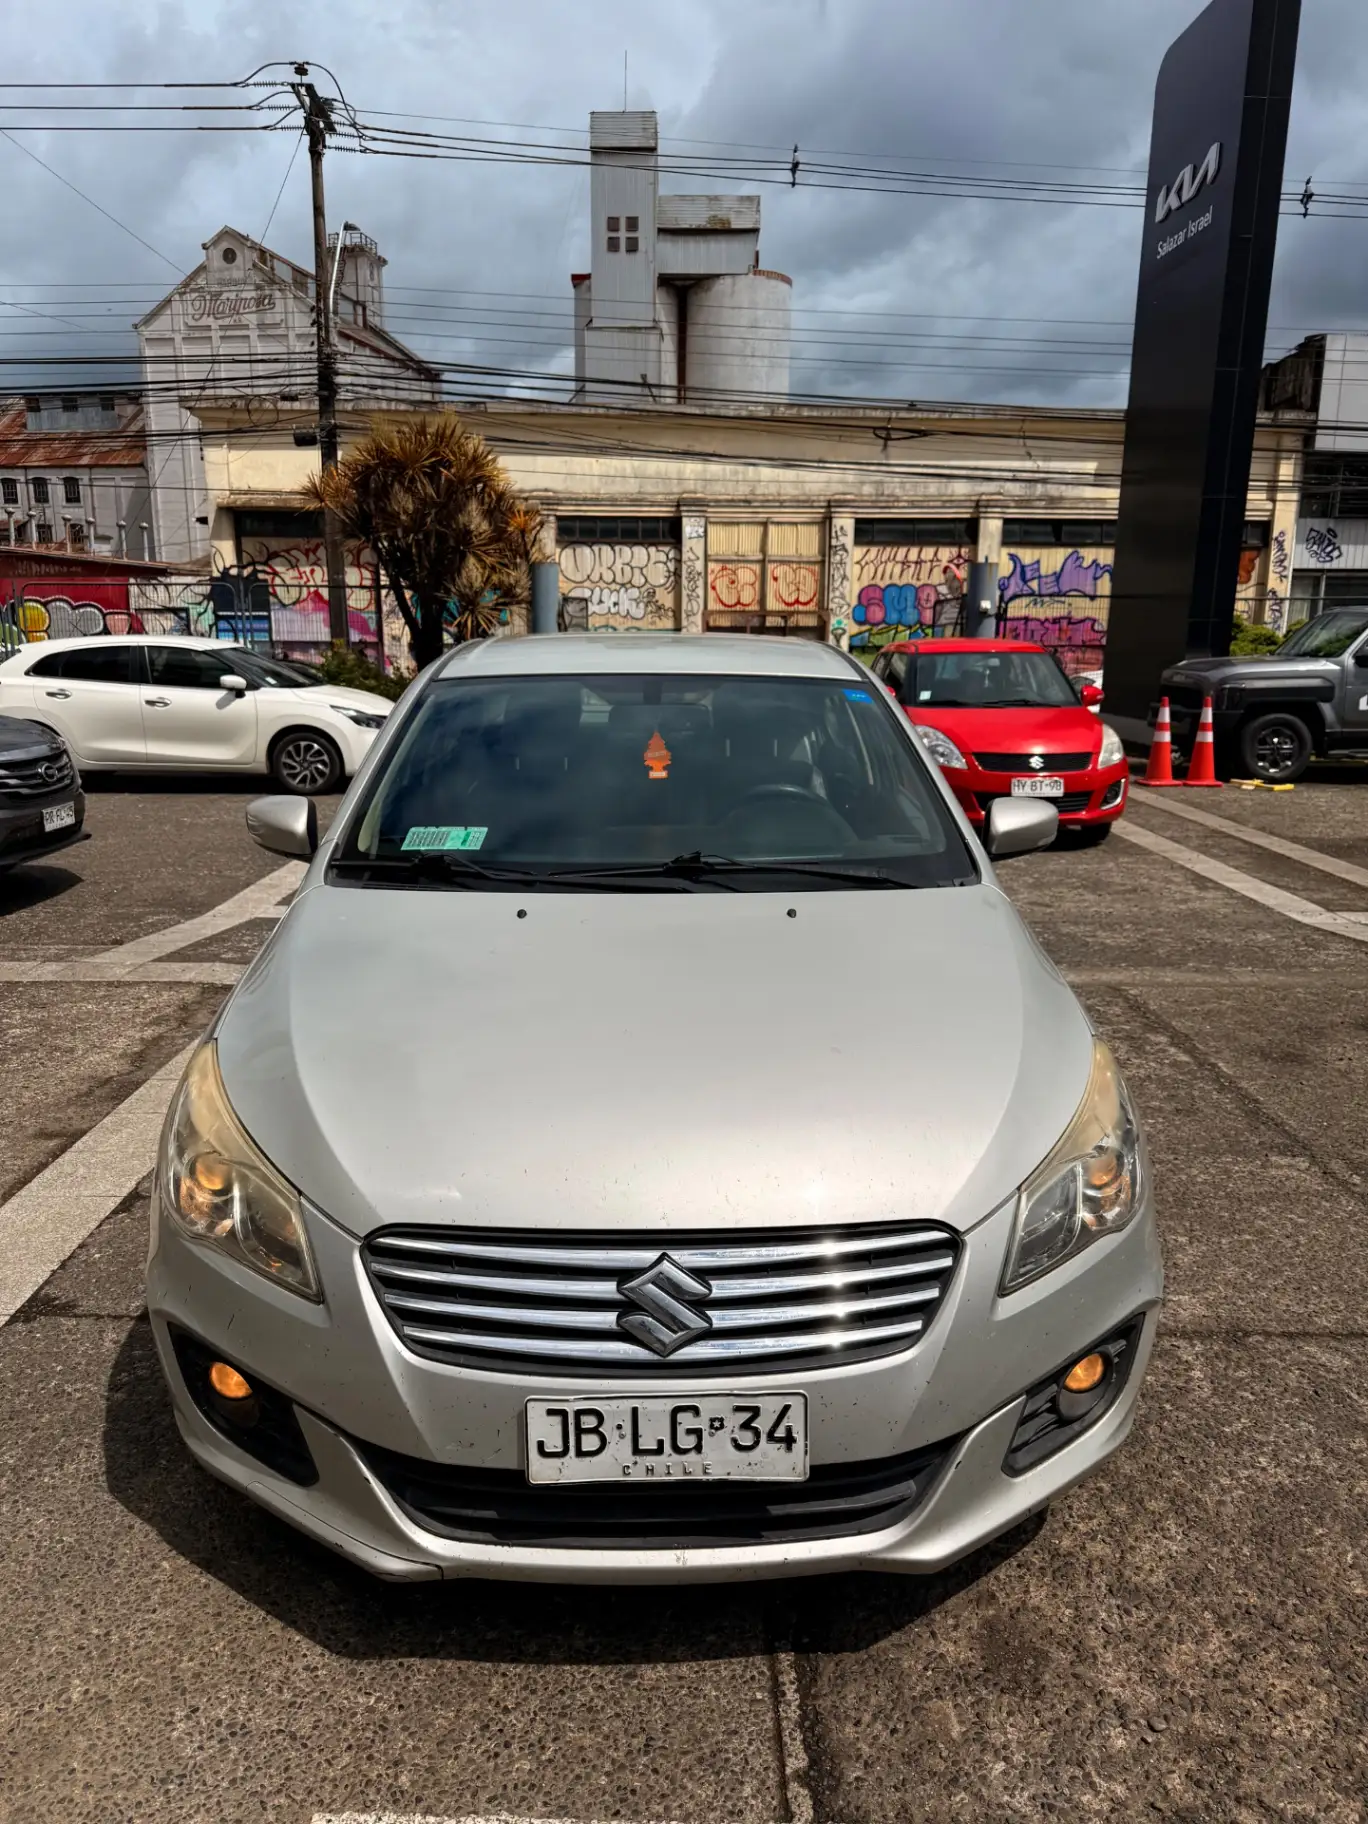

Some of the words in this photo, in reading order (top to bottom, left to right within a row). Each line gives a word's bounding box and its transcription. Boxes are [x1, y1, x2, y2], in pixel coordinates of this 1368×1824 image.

[1156, 227, 1187, 259] Salazar
[1188, 205, 1212, 237] Israel
[622, 1460, 715, 1478] CHILE
